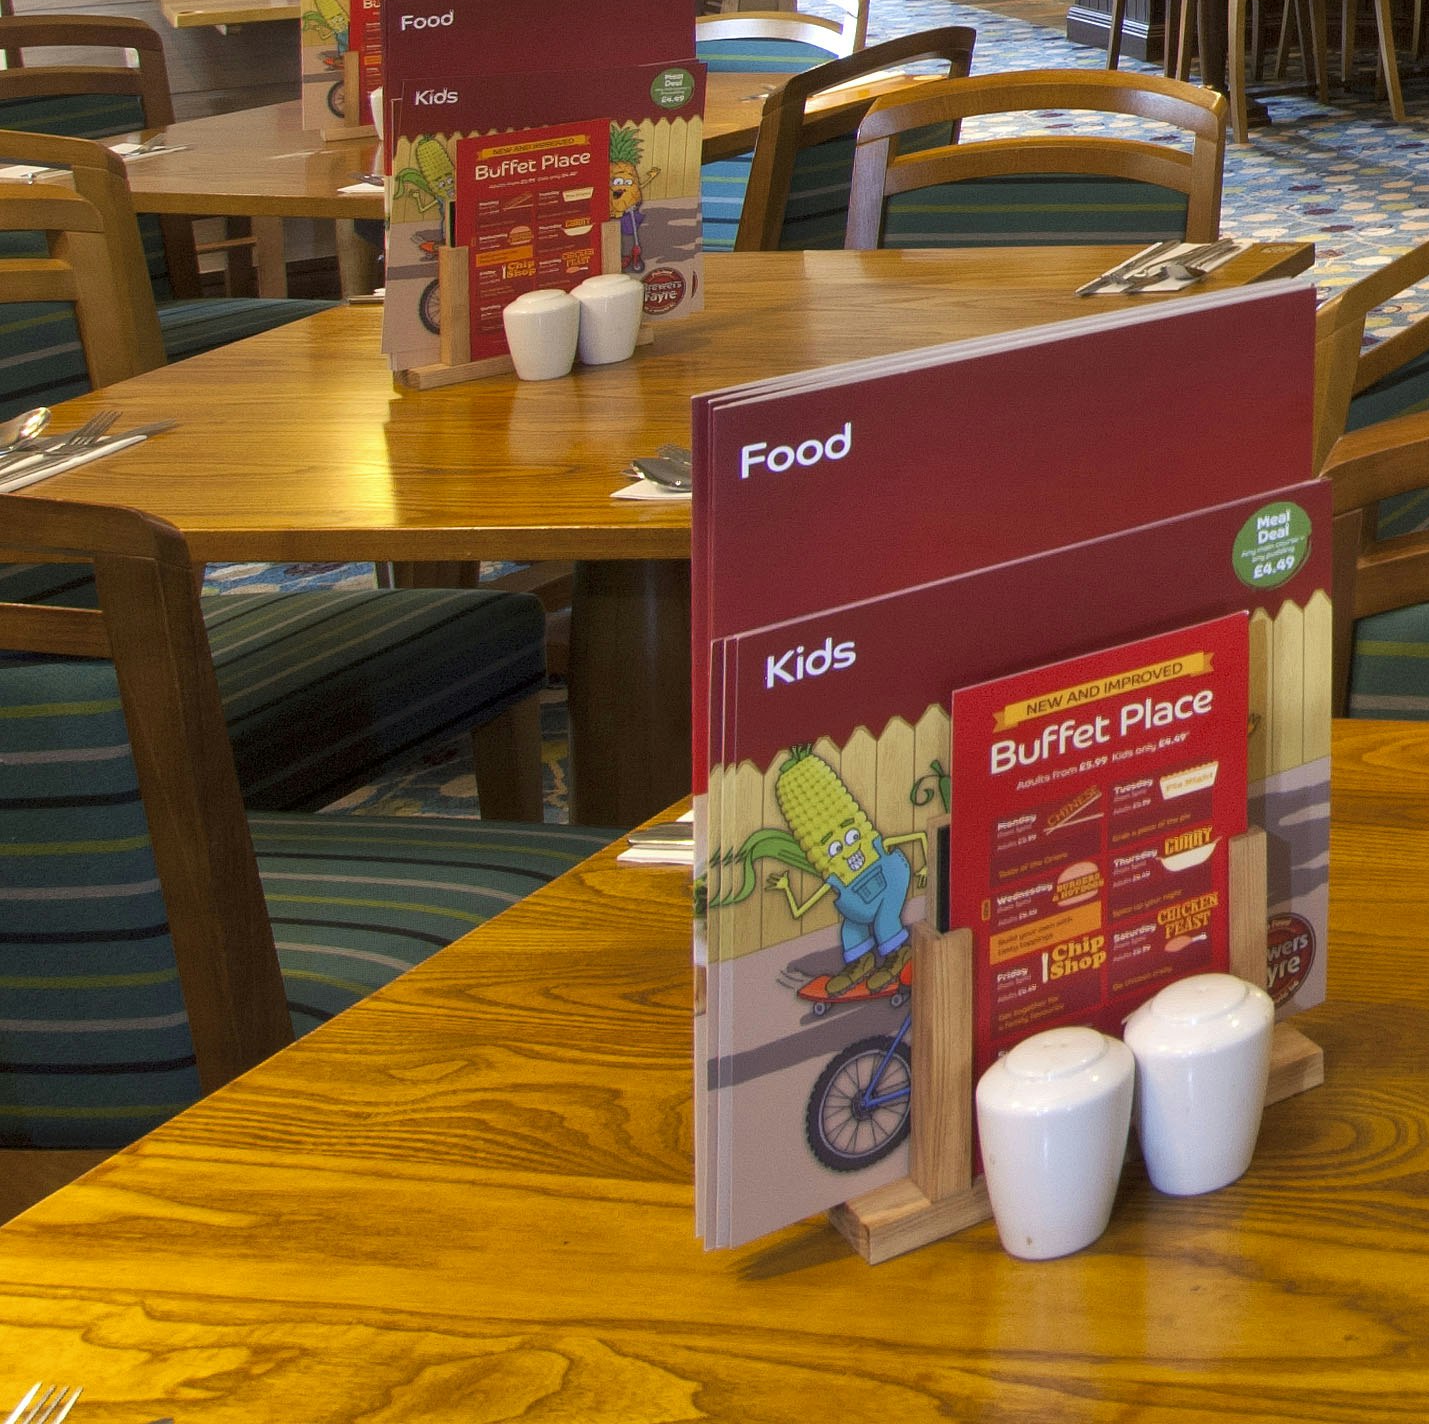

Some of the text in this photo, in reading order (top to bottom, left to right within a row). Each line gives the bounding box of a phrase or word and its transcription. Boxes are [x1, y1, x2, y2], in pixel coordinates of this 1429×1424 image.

[401, 9, 454, 31] Food
[414, 88, 459, 106] Kids
[475, 158, 537, 181] Buffet
[541, 150, 592, 172] Place
[741, 422, 853, 479] Food
[1257, 509, 1291, 529] Meal
[1258, 523, 1290, 544] Deal
[1253, 556, 1295, 580] £4.49
[765, 637, 857, 689] Kids
[1026, 662, 1183, 716] NEW AND IMPROVED
[990, 689, 1214, 776] Buffet Place
[1016, 774, 1051, 791] Adults
[1052, 766, 1078, 779] from
[1112, 748, 1135, 762] Kids
[1135, 742, 1158, 756] only
[1113, 778, 1153, 794] Tuesday
[1047, 784, 1100, 826] CHINESE
[1164, 825, 1213, 856] CURRY
[997, 883, 1053, 906] Wednesday
[1158, 891, 1219, 925] CHICKEN
[1113, 923, 1157, 943] Saturday
[1165, 910, 1212, 940] FEAST
[1051, 936, 1105, 962] Chip
[1267, 934, 1308, 962] wers
[997, 967, 1029, 982] Friday
[1050, 950, 1106, 981] Shop
[1267, 956, 1300, 989] yre
